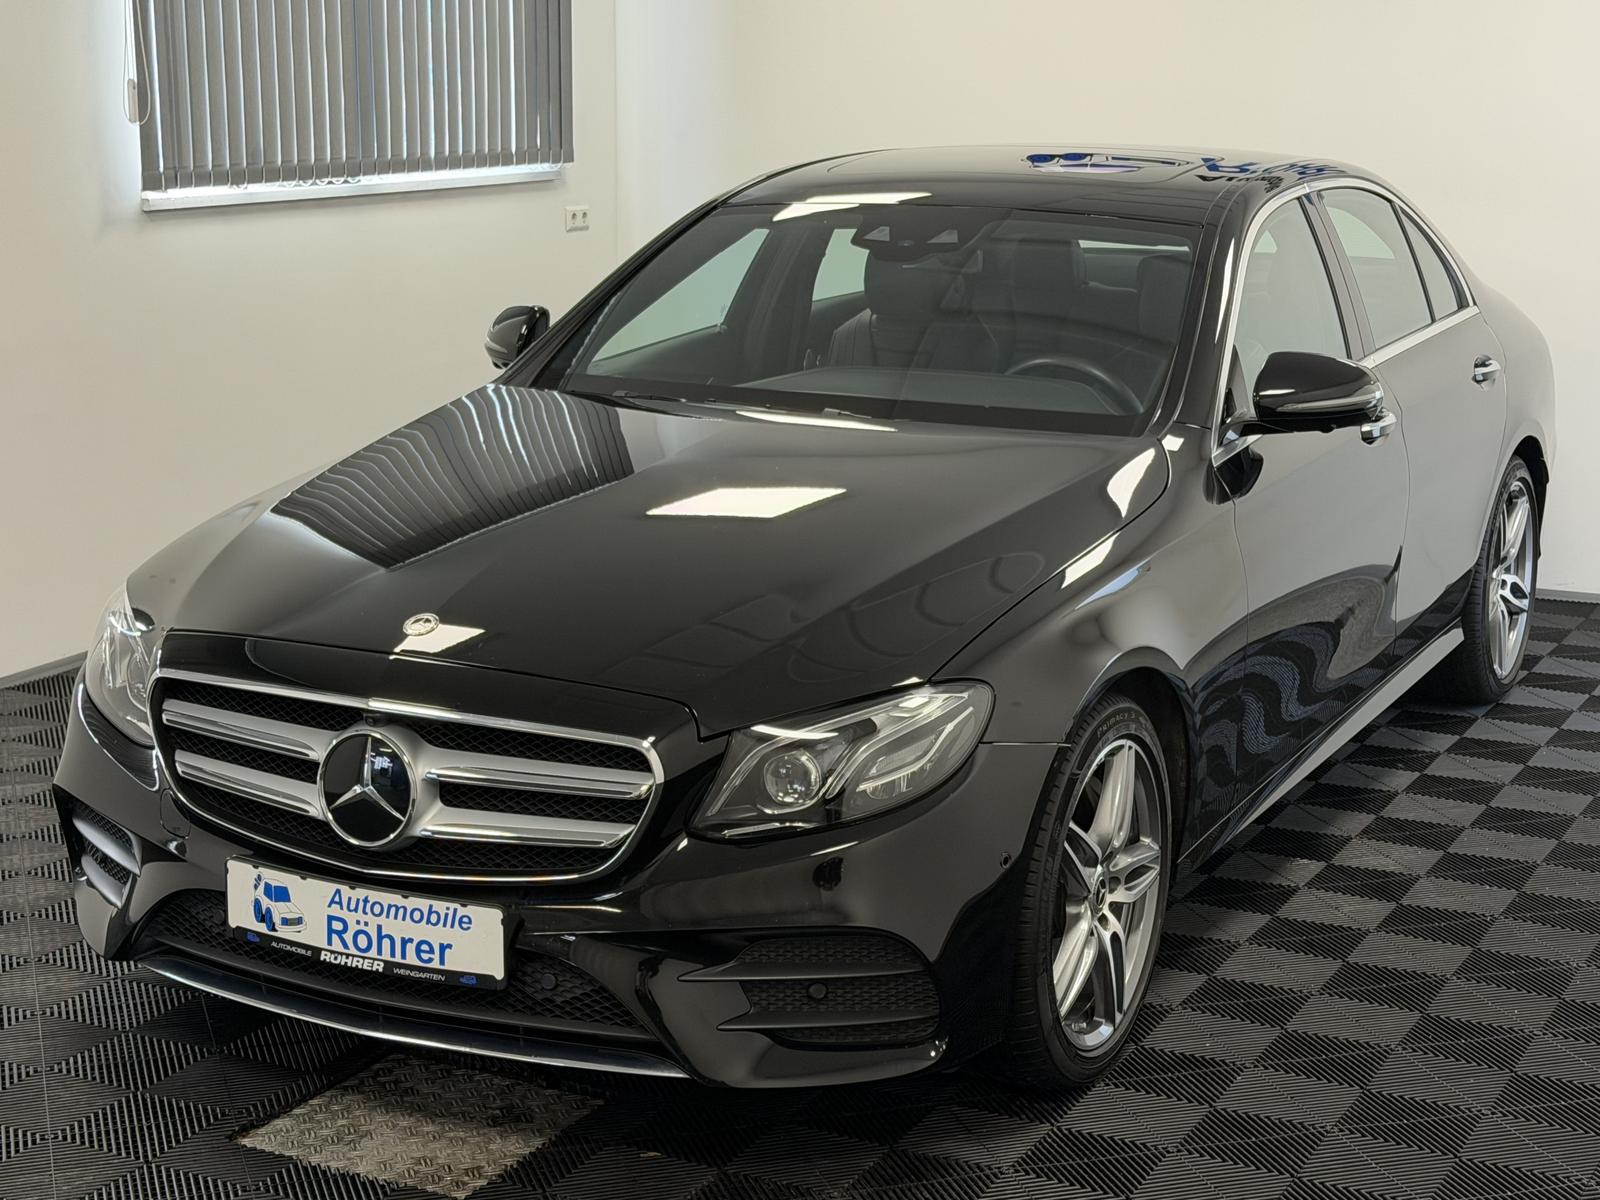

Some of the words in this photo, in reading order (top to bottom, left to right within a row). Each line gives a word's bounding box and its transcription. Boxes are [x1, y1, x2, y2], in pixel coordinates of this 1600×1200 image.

[327, 888, 473, 931] Automobile
[271, 941, 312, 956] AUTOMOBILE
[320, 950, 384, 973] RÖHRER
[393, 967, 446, 982] WEINGARTEN
[326, 914, 453, 966] Röhrer
